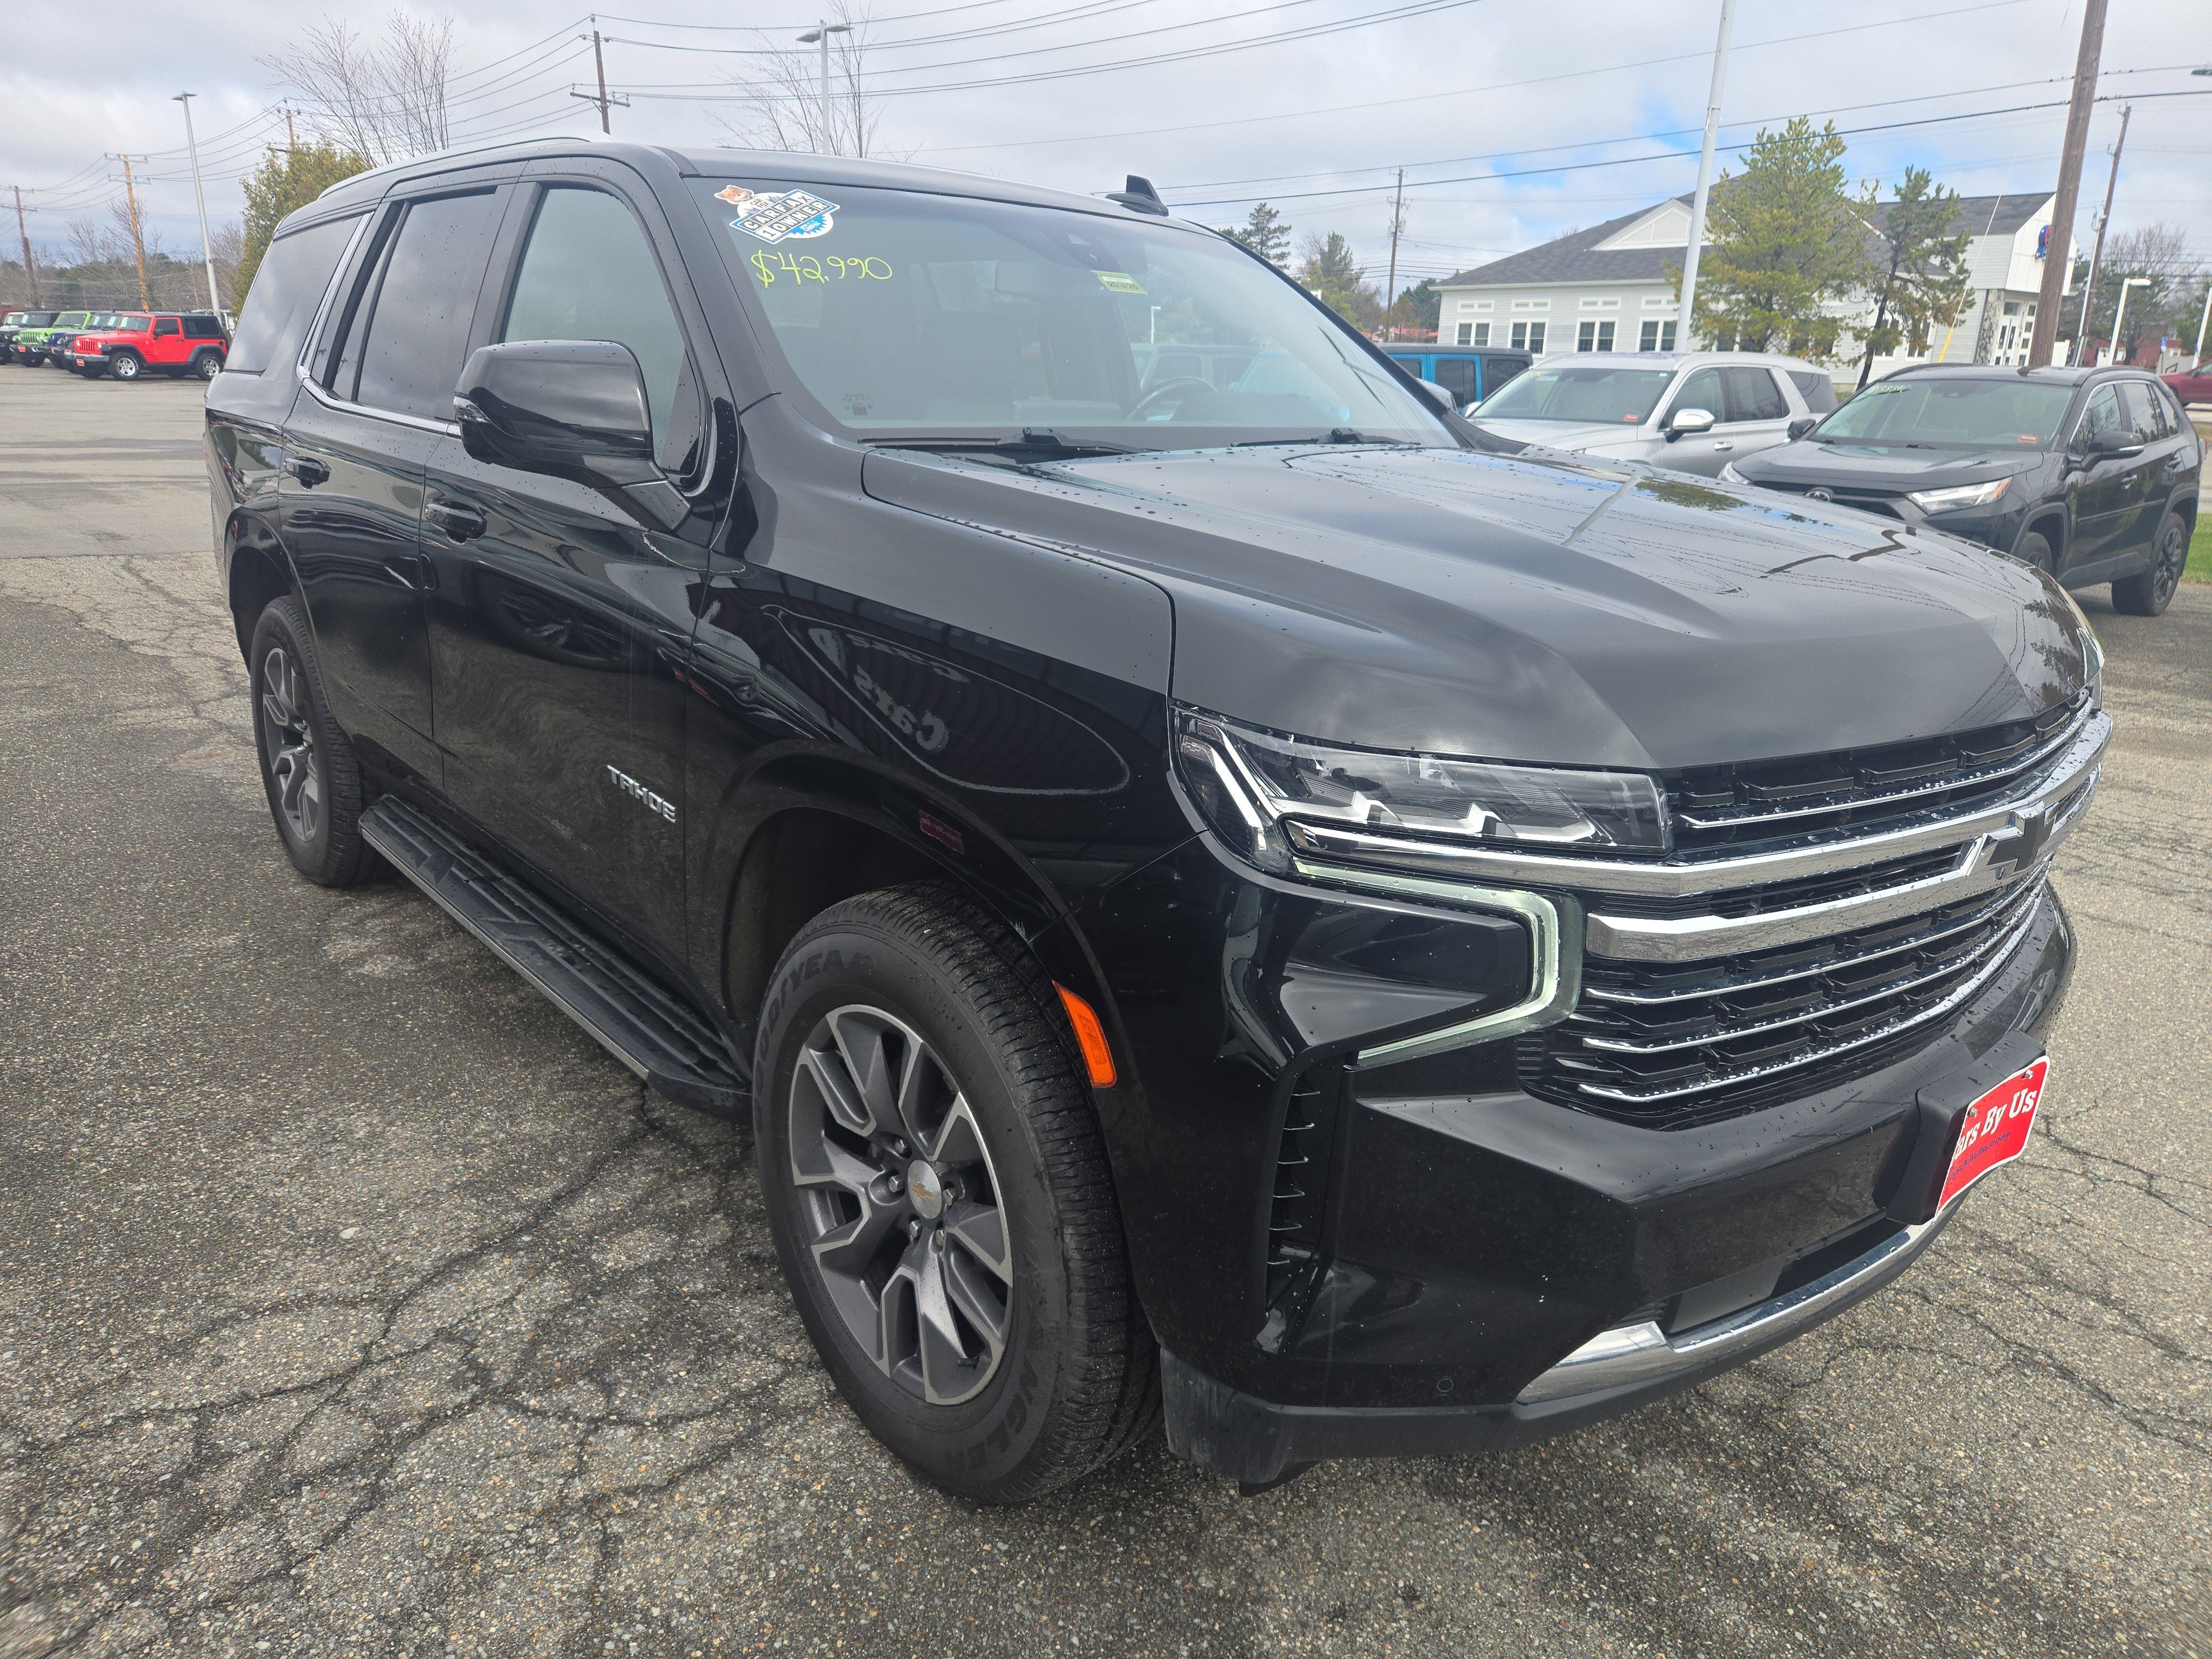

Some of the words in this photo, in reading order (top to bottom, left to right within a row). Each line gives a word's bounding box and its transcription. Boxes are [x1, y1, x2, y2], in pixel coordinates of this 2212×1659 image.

[744, 195, 812, 229] CARFAX
[773, 201, 828, 231] OWNER
[750, 249, 892, 288] $42,990
[606, 764, 677, 824] TAHOE
[1980, 1103, 2008, 1137] By
[2009, 1088, 2037, 1118] Us
